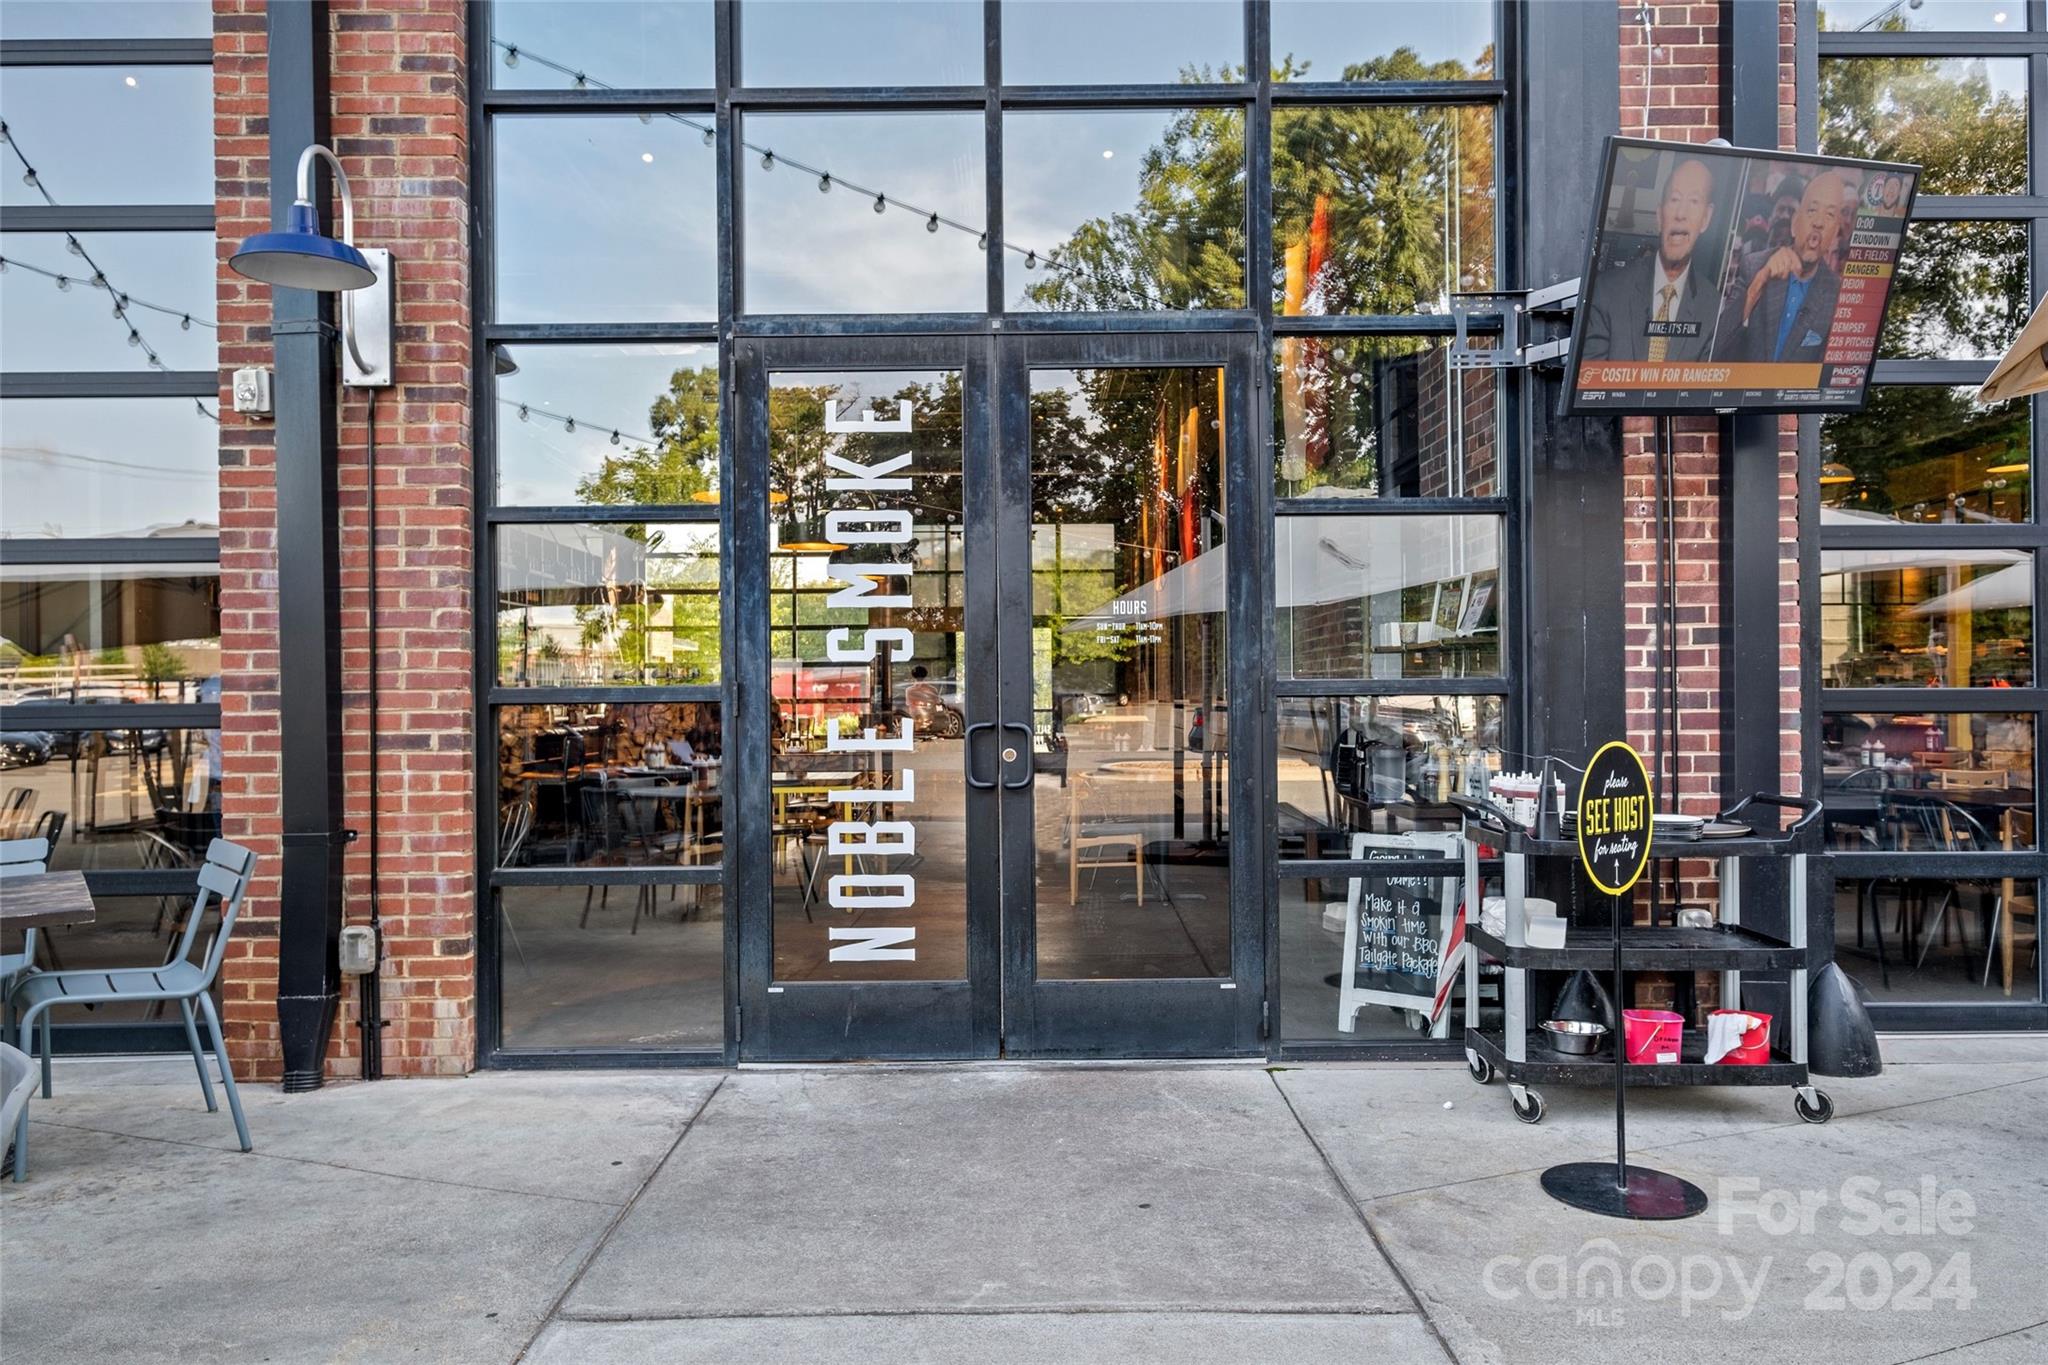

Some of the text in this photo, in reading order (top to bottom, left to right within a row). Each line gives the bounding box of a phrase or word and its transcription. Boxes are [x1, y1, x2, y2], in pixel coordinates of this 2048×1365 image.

[1856, 217, 1875, 229] 0:00
[1852, 233, 1891, 246] RUNDOWN
[1848, 249, 1889, 261] NFL FIELDS
[1845, 263, 1880, 276] RANGERS
[1842, 278, 1866, 289] DEION
[1835, 308, 1853, 318] JETS
[1668, 323, 1682, 333] IT'S
[1832, 322, 1867, 332] DEMPSEY
[1845, 336, 1876, 347] PITCHES
[1601, 367, 1731, 383] COSTLY WIN FOR RANGERS?
[1832, 366, 1866, 376] PARDON
[1582, 391, 1606, 400] ESPN
[825, 399, 914, 663] SMOKE
[1112, 600, 1147, 615] HOURS
[1603, 770, 1629, 796] please
[1585, 795, 1645, 836] SEE HOST
[827, 717, 916, 963] NOBLE
[1594, 834, 1638, 863] for seating
[1365, 893, 1420, 916] Make it a
[1391, 936, 1409, 949] our
[1413, 936, 1439, 955] BBQ
[1359, 946, 1397, 970] Tailgate
